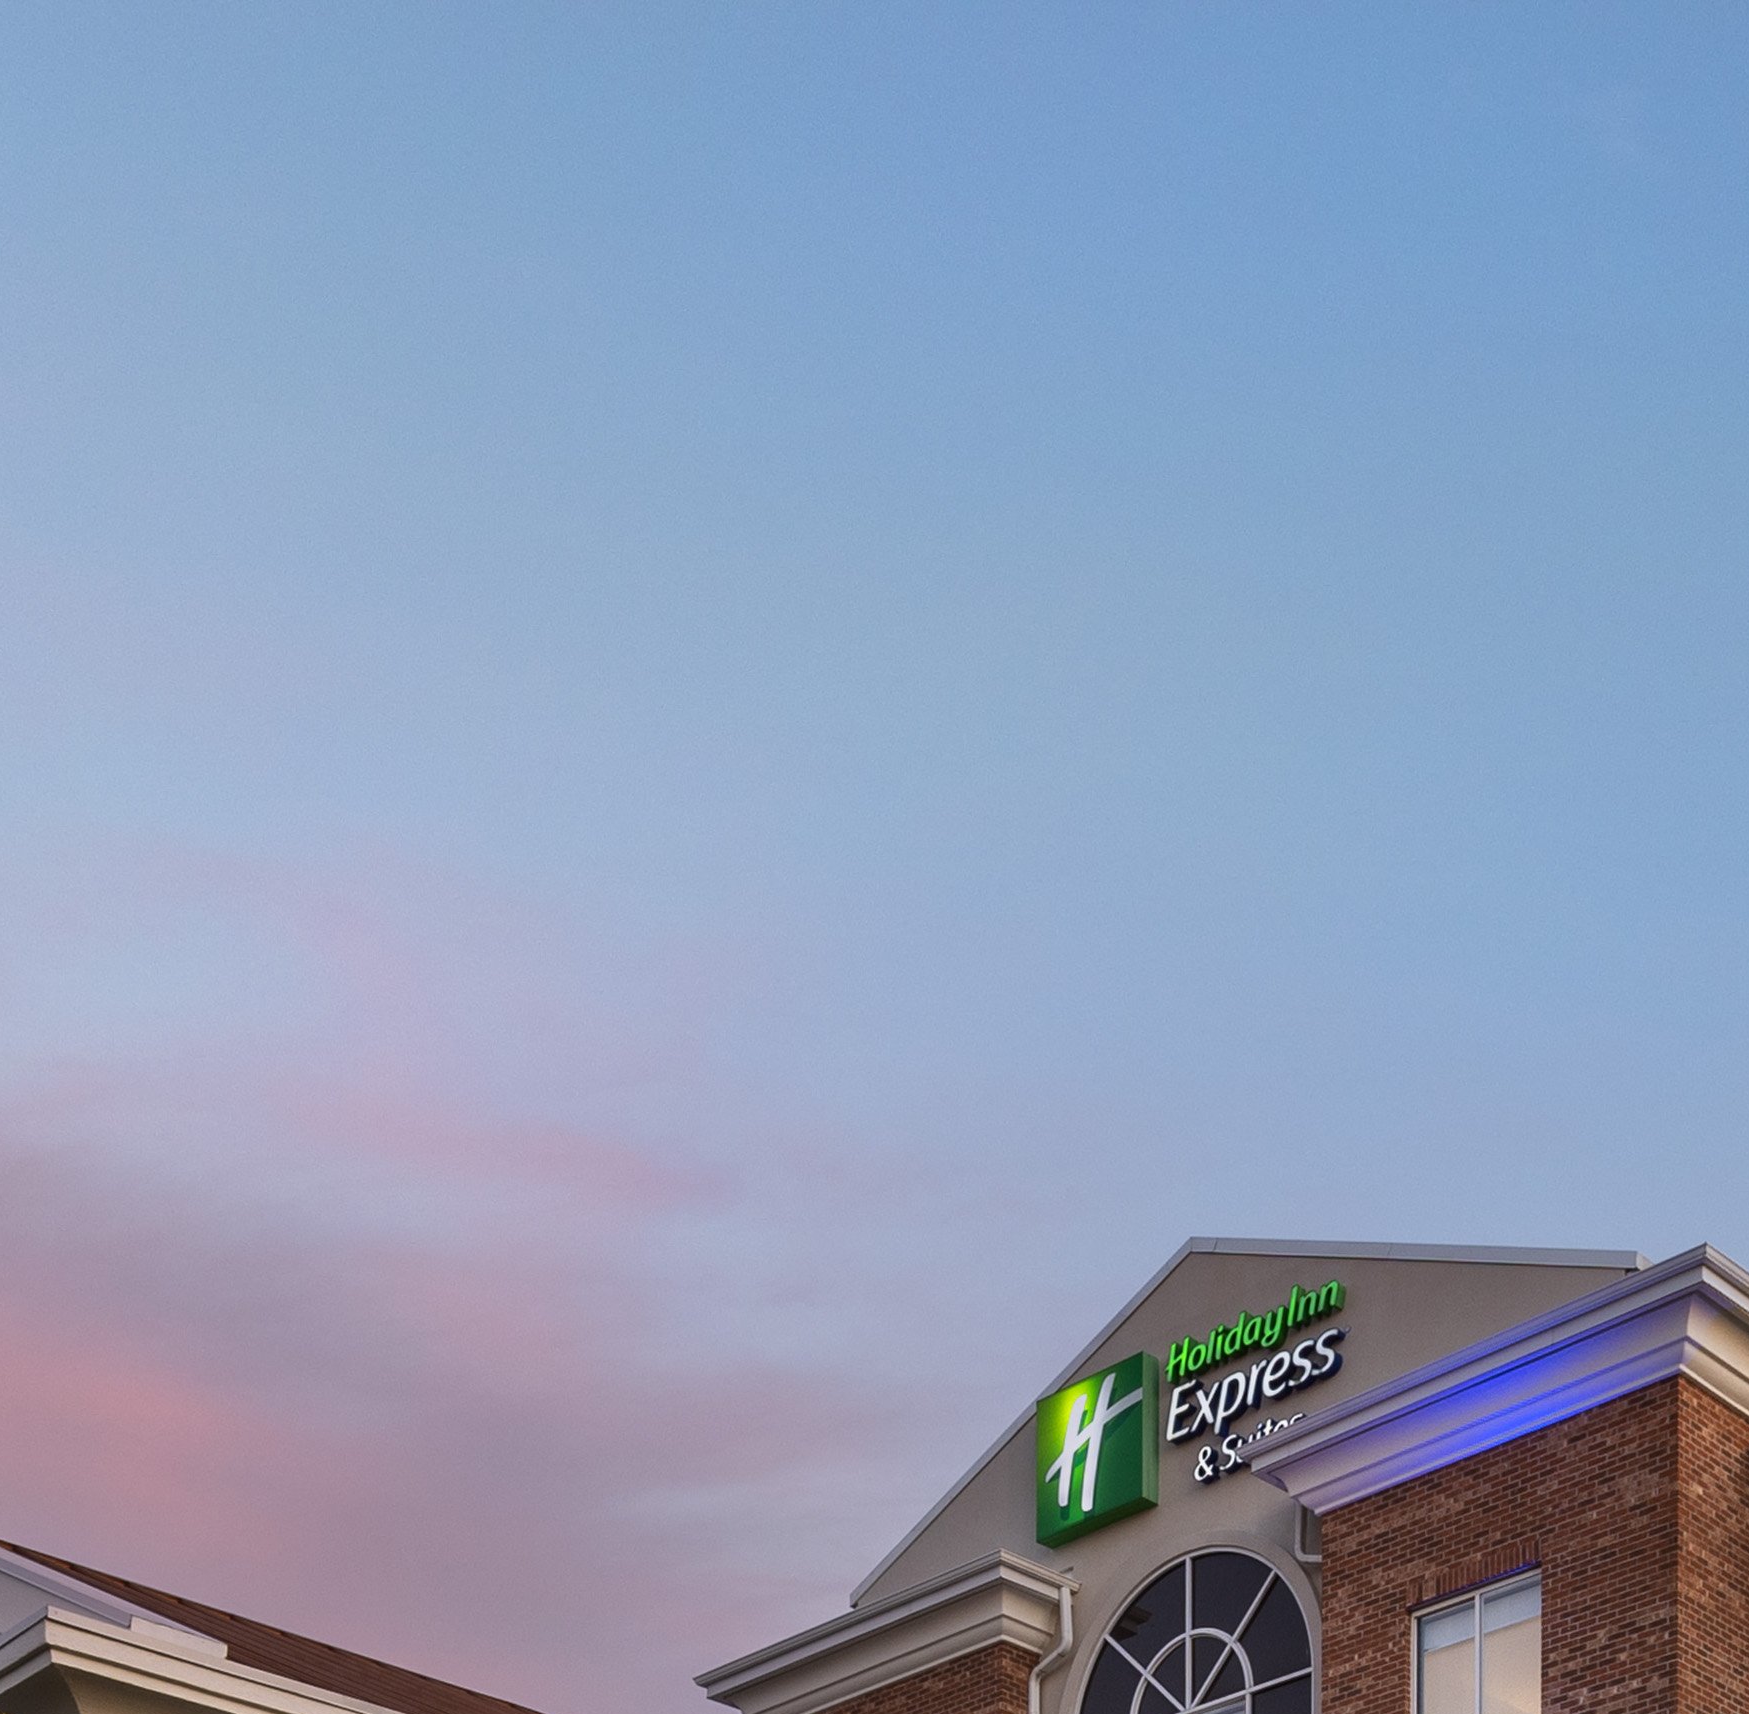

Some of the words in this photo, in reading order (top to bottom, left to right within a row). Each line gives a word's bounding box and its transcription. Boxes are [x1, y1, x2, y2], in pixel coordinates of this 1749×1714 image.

[1164, 1304, 1287, 1383] Holiday
[1287, 1279, 1343, 1328] Inn
[1165, 1327, 1341, 1442] Express
[1193, 1445, 1215, 1482] &
